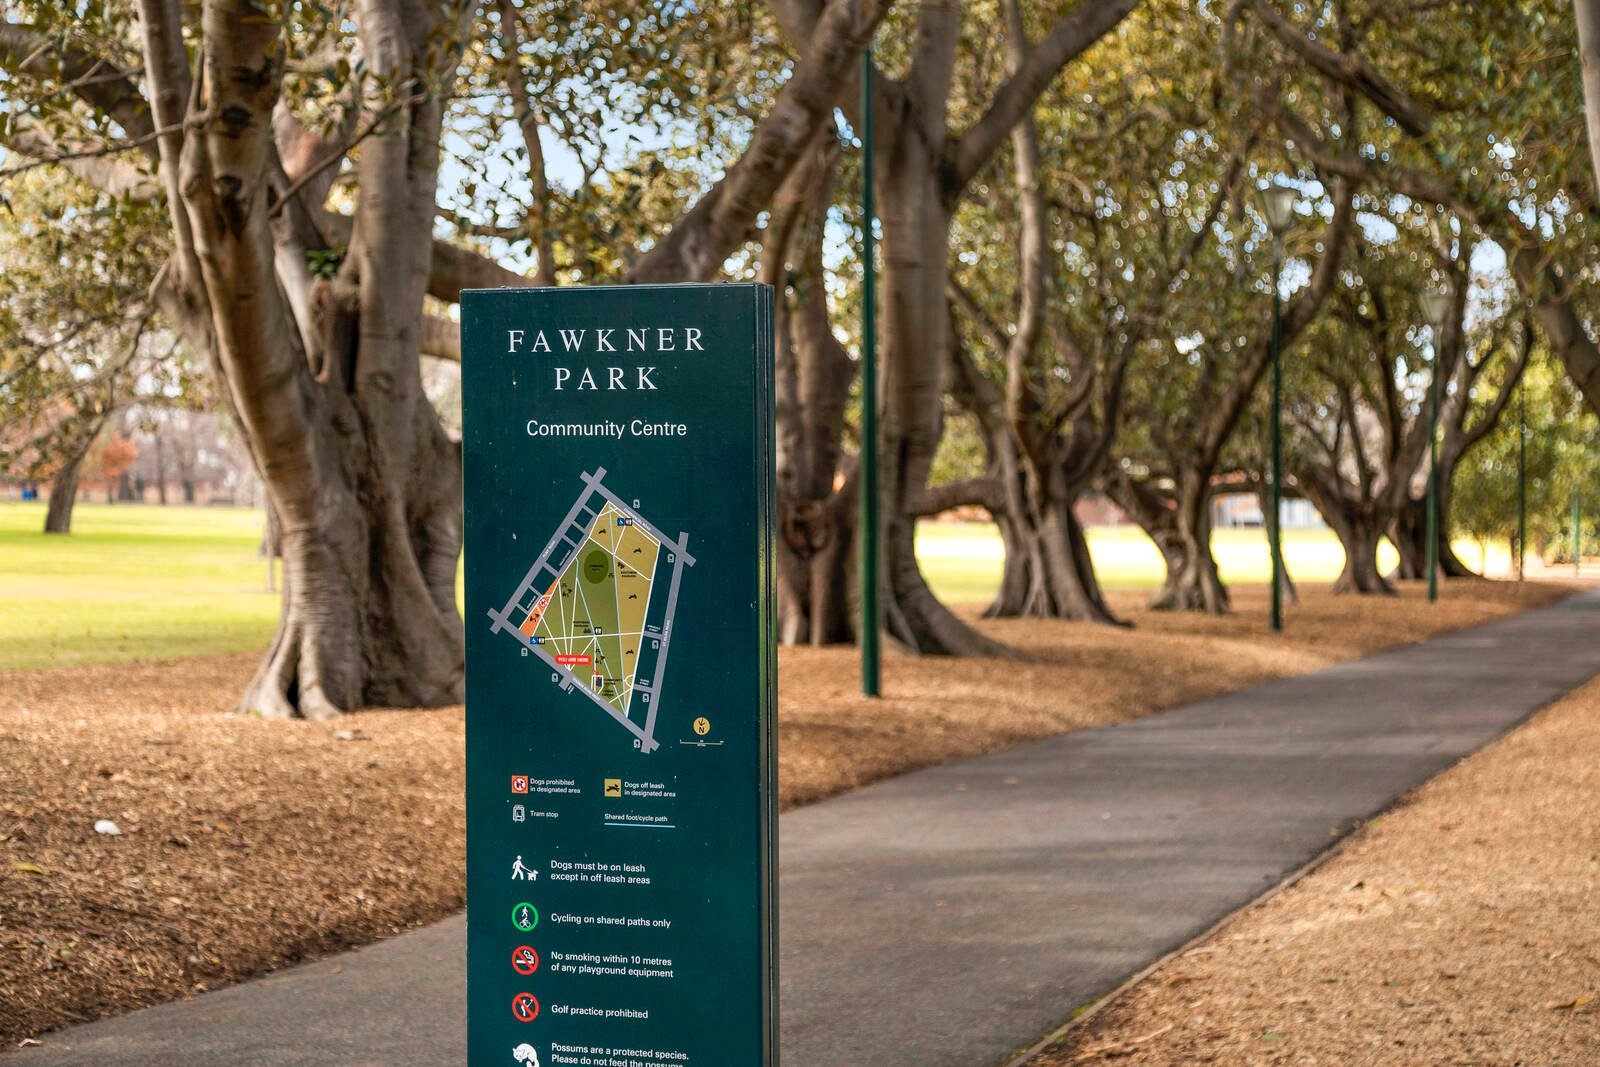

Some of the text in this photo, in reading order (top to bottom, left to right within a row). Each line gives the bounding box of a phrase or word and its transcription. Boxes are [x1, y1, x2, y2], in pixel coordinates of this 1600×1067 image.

[508, 328, 704, 352] FAWKNER
[555, 367, 657, 390] PARK
[527, 420, 687, 438] Community Centre
[551, 860, 572, 870] Dogs
[575, 862, 595, 870] must
[624, 863, 645, 872] leash
[551, 874, 578, 882] except
[604, 874, 625, 883] leash
[551, 913, 581, 924] Cycling
[597, 916, 624, 924] shared
[628, 918, 650, 927] paths
[653, 919, 671, 928] only
[551, 952, 563, 960] No
[566, 953, 600, 964] smoking
[603, 954, 628, 963] within
[643, 958, 672, 966] metres
[562, 965, 576, 974] any
[579, 965, 626, 975] playground
[629, 968, 673, 978] equipment
[552, 1005, 648, 1018] Golf practice prohibited
[552, 1043, 588, 1053] Possums
[613, 1047, 652, 1058] protected
[655, 1050, 689, 1060] species.
[552, 1054, 578, 1064] Please
[580, 1056, 591, 1065] do
[609, 1058, 627, 1067] feed
